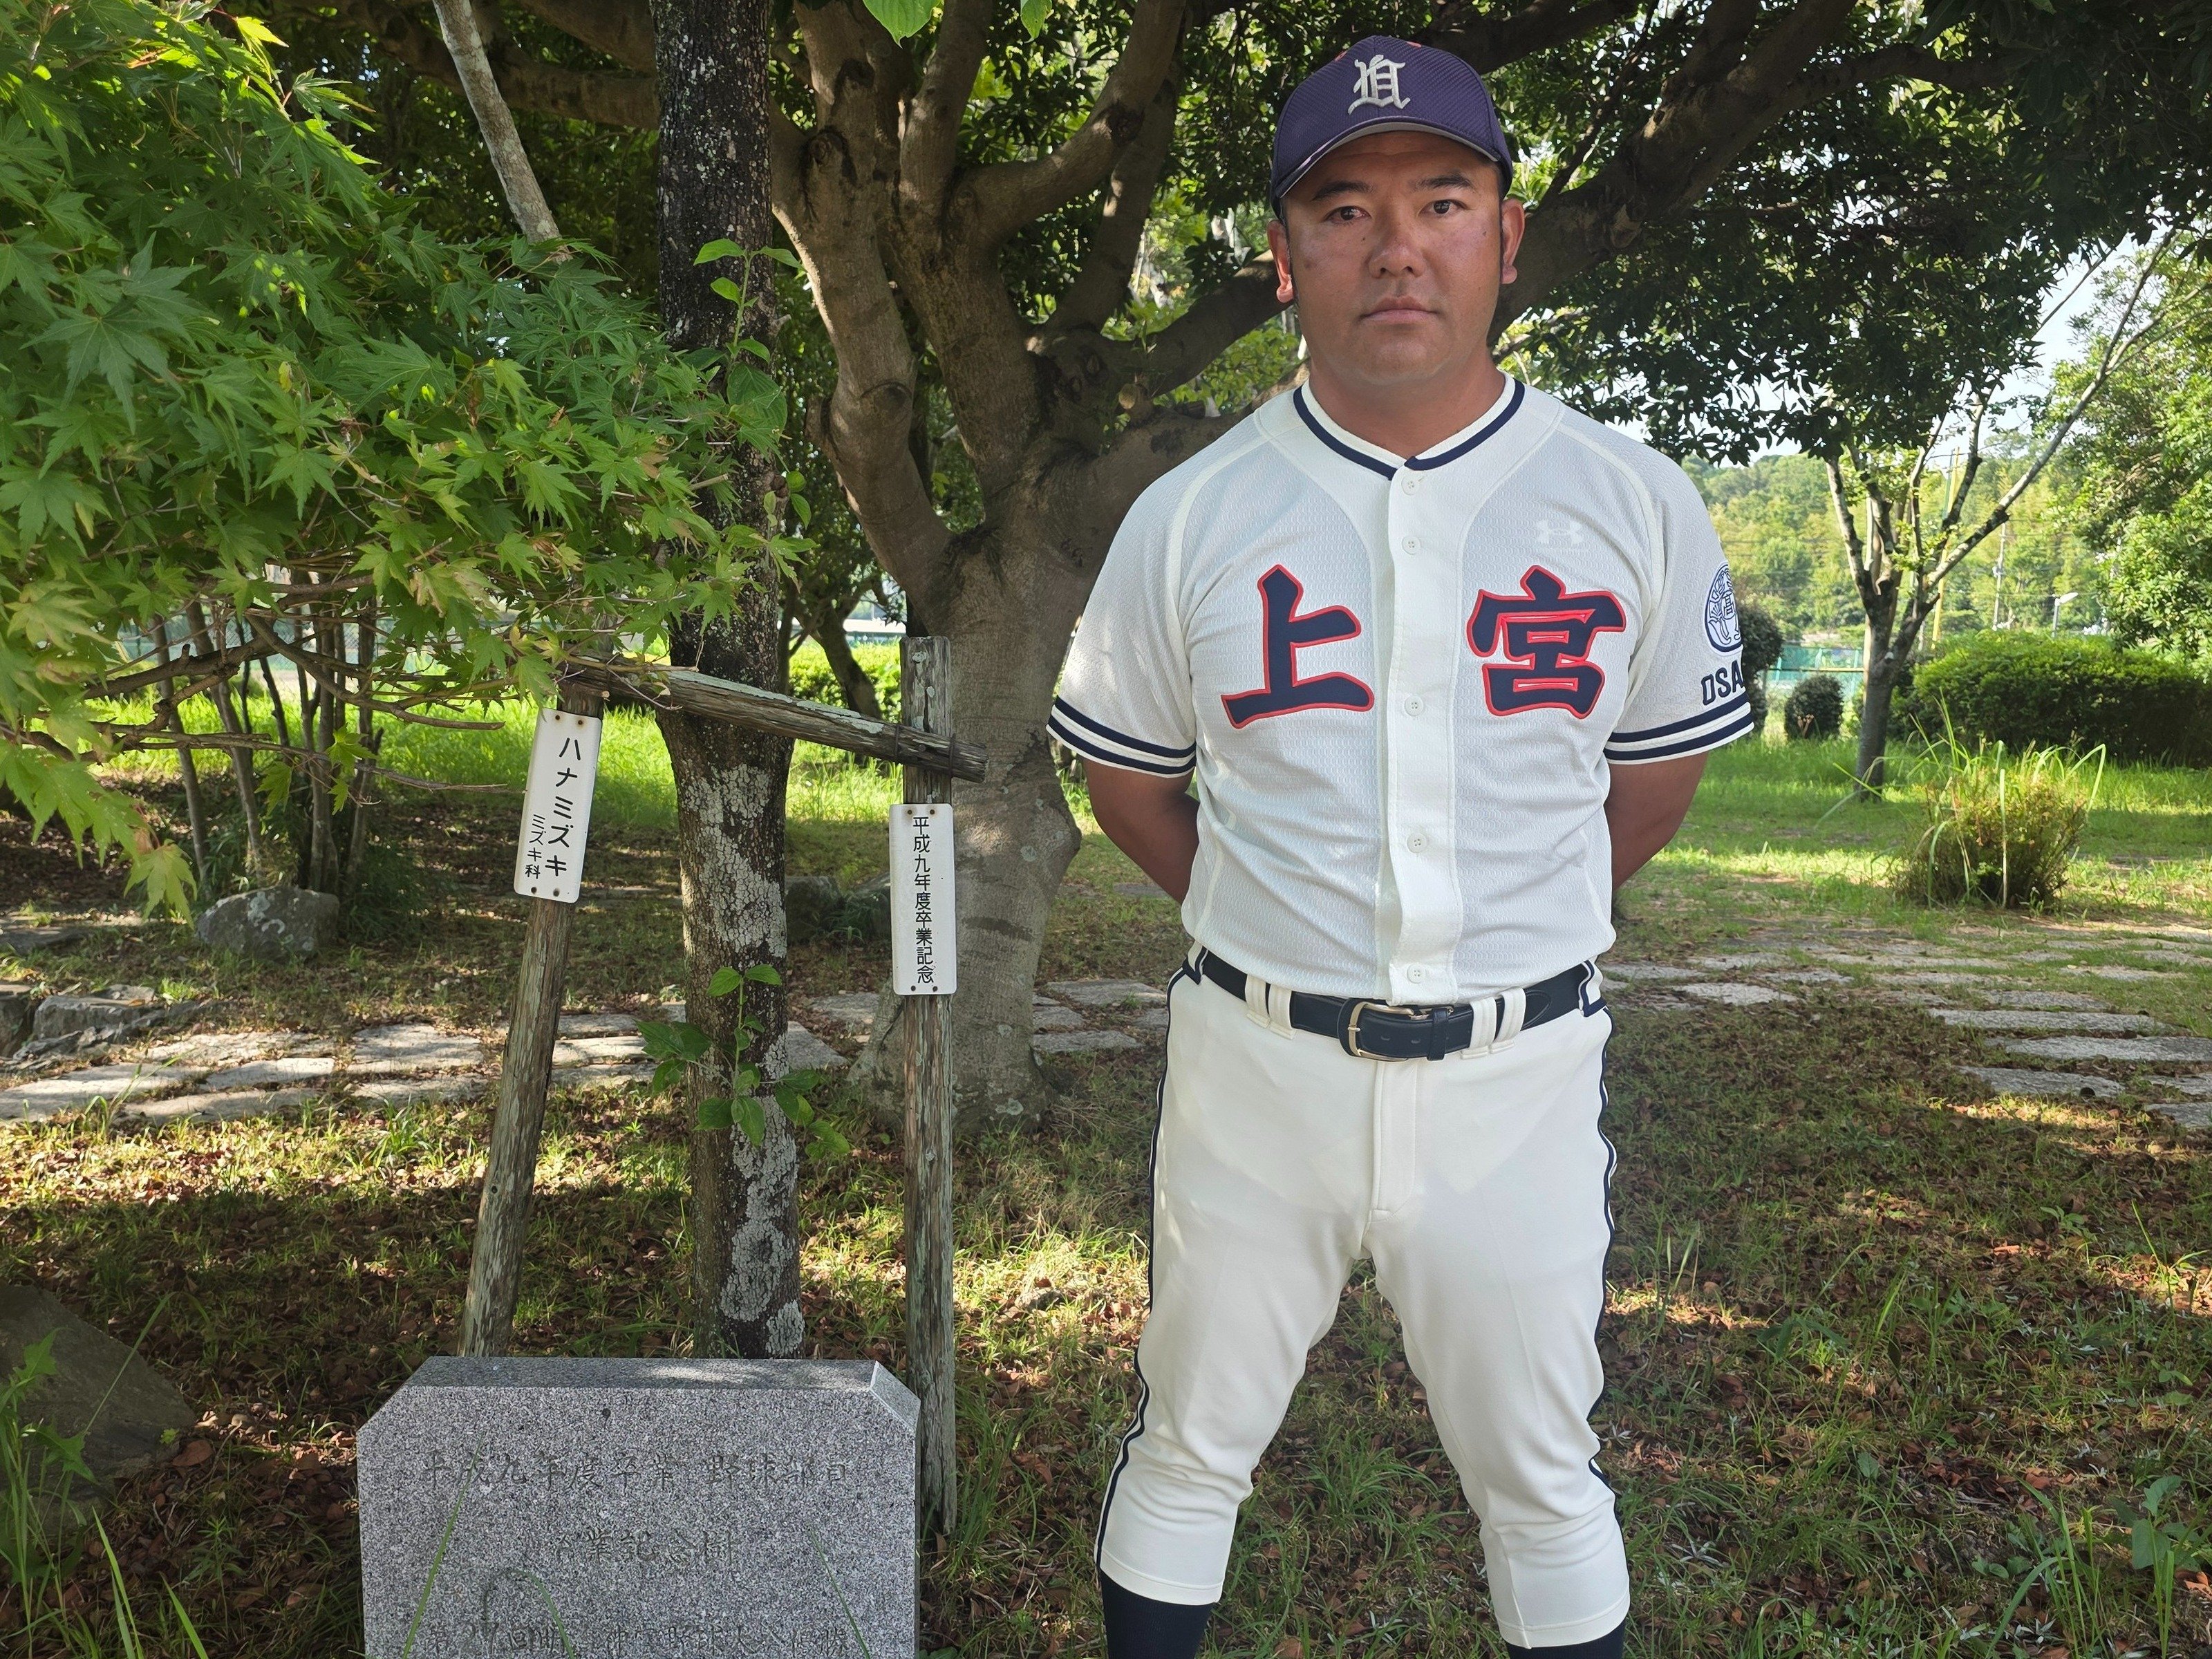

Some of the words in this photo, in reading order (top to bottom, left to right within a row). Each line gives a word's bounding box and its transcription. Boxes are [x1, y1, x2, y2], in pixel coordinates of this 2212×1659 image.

[524, 814, 547, 879] ミズキ科
[545, 737, 581, 877] ハナミズキ
[912, 816, 934, 984] 平成九年度卒業記念
